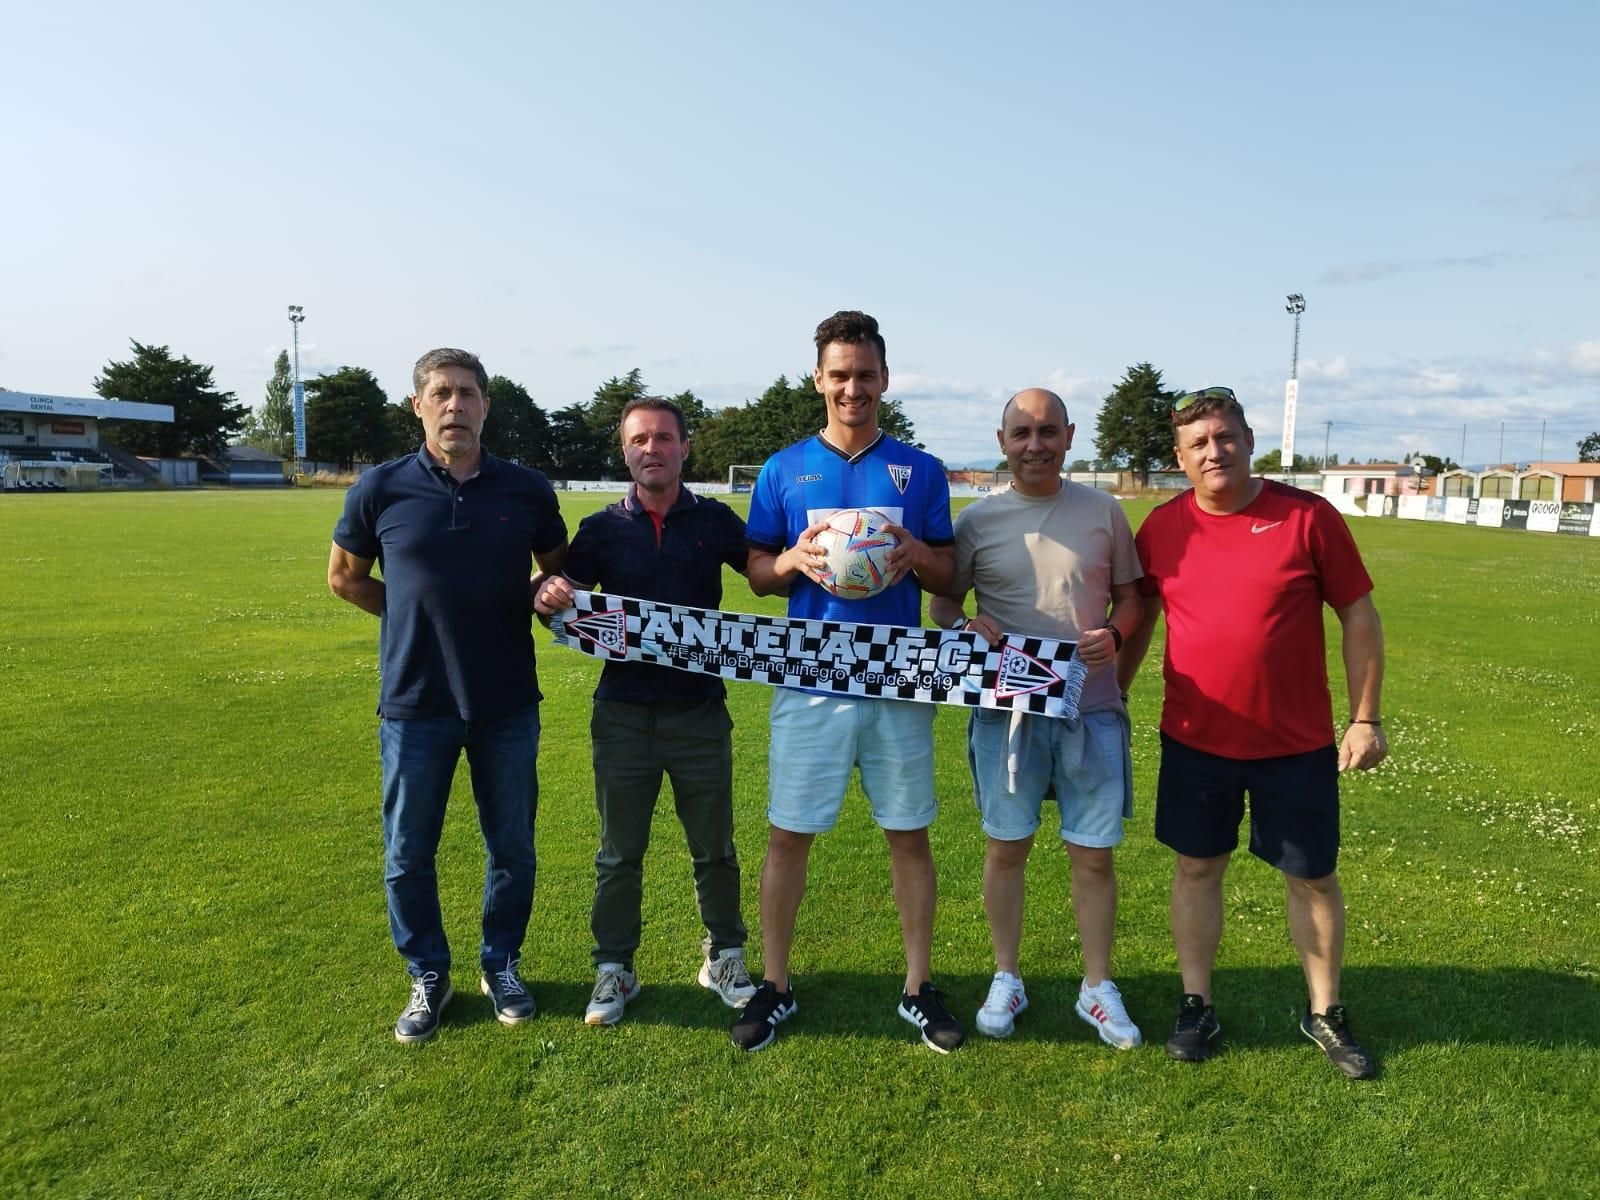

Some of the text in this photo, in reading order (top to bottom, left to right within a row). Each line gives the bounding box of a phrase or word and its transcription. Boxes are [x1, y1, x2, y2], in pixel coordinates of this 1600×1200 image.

[640, 610, 859, 664] ANTELA
[855, 669, 907, 687] dende
[913, 674, 953, 691] 1919
